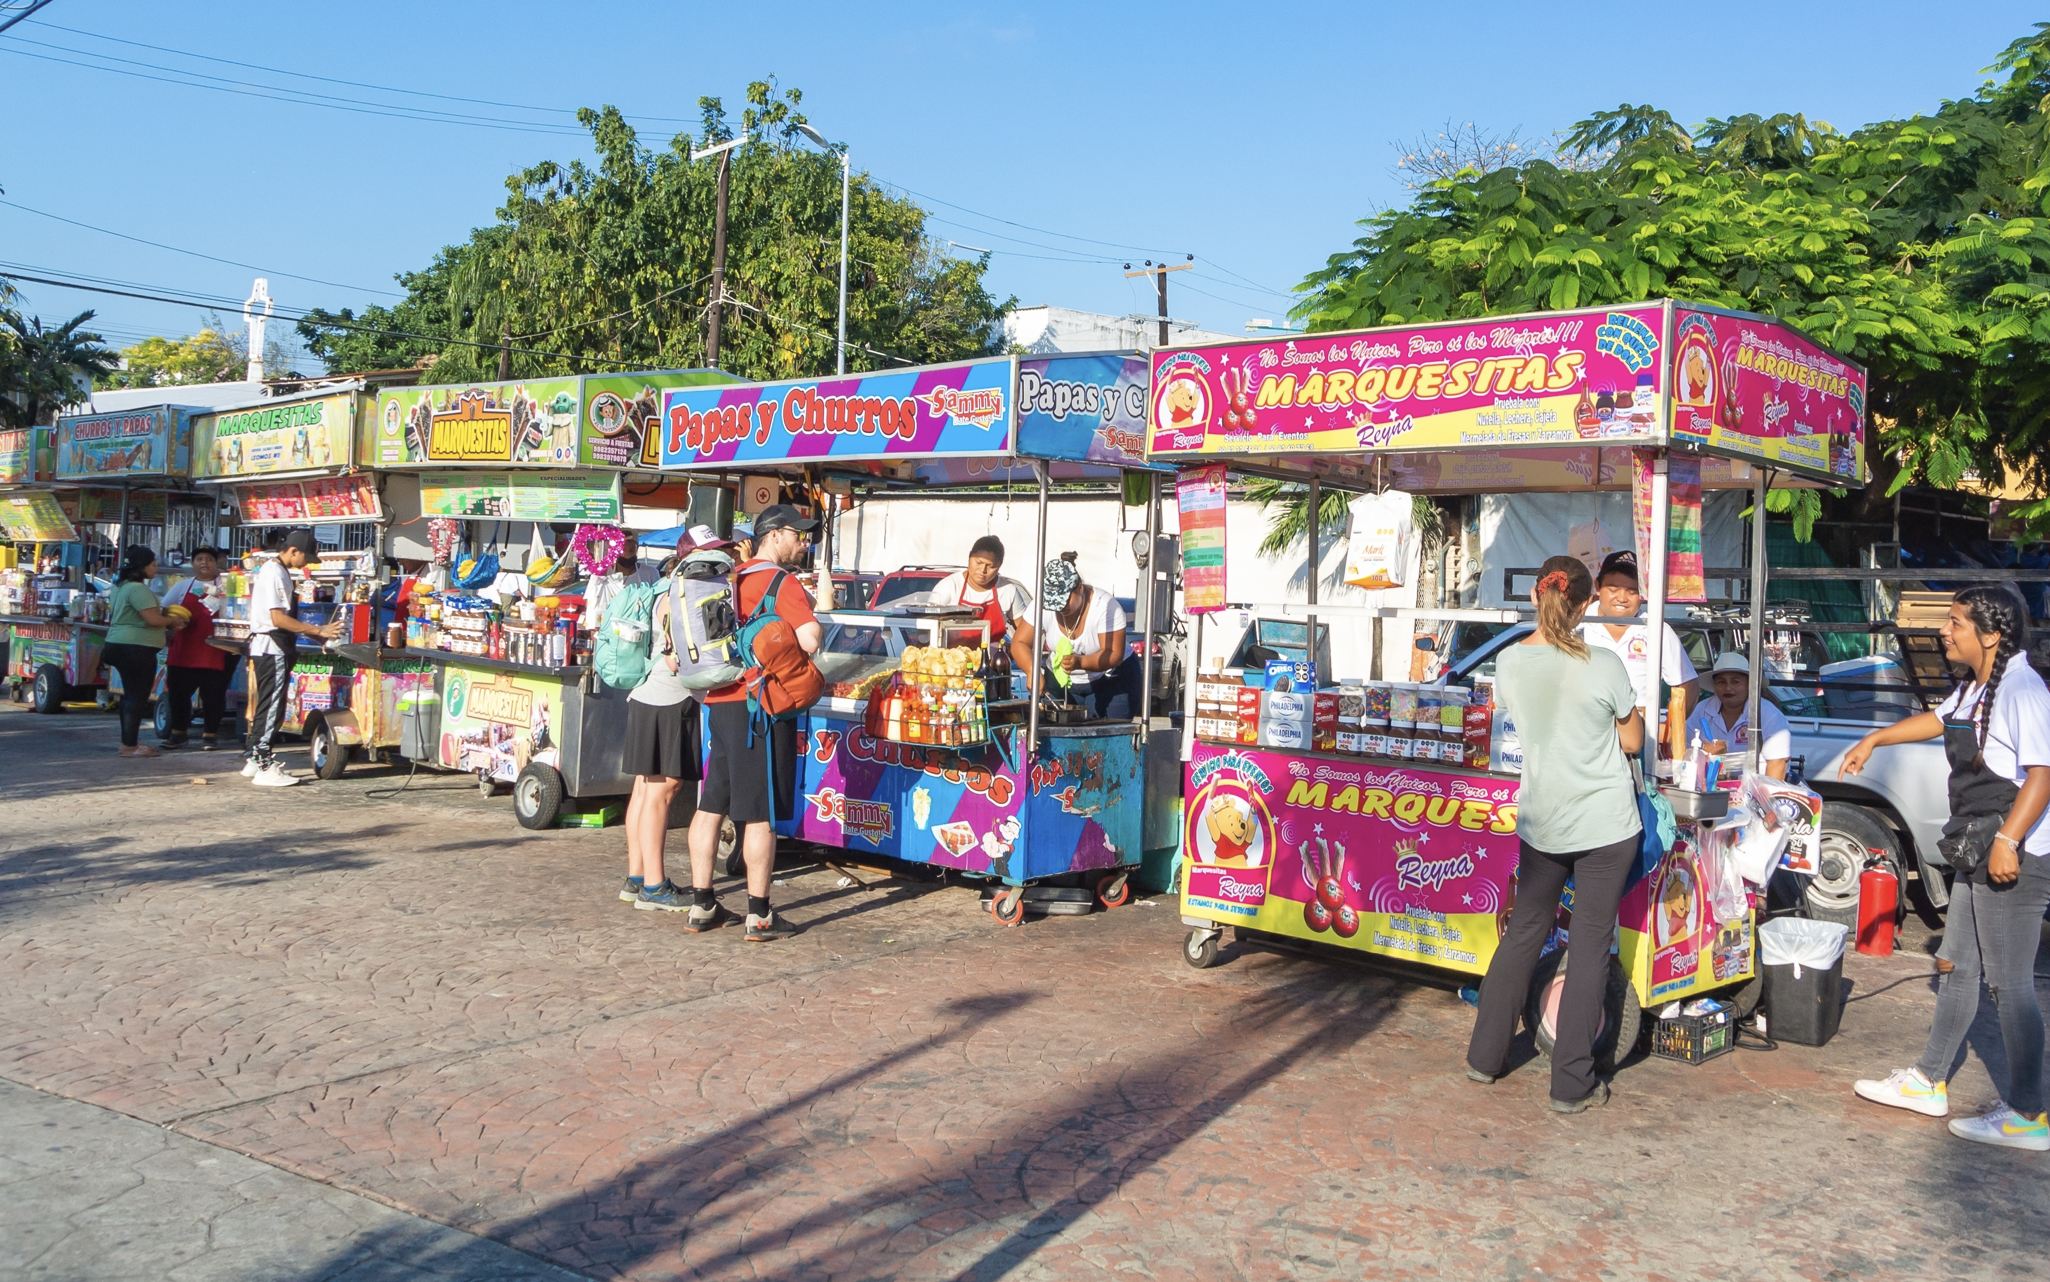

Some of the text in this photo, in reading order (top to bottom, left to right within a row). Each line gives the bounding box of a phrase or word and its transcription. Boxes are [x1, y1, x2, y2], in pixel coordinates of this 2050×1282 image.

[1259, 349, 1278, 367] No
[1282, 348, 1325, 366] Somos
[1329, 345, 1348, 362] los
[1408, 336, 1442, 357] Pero
[1465, 332, 1486, 349] los
[1491, 321, 1583, 351] Mejores!!!
[1598, 326, 1652, 366] CON QUESO
[1608, 314, 1658, 349] RELLENAS
[1599, 339, 1640, 372] DE BOLA
[1736, 344, 1848, 398] MARQUESITAS
[1255, 351, 1585, 409] MARQUESITAS
[933, 389, 1000, 416] Sammy
[1020, 372, 1099, 419] Papas
[1103, 388, 1120, 421] y
[75, 414, 152, 440] CHURROS Y PAPAS
[216, 402, 323, 437] MARQUESITAS
[669, 405, 751, 453] Papas
[756, 402, 777, 444] y
[783, 389, 917, 438] Churros
[1764, 401, 1789, 426] Reyna
[432, 418, 507, 460] MARQUESITAS
[1279, 431, 1308, 440] Eventos
[1356, 416, 1413, 447] Reyna
[1269, 666, 1293, 676] OREO
[1270, 701, 1304, 711] PHILADELPHIA
[815, 731, 841, 763] y
[1268, 728, 1302, 739] PHILADELPHIA
[1222, 755, 1242, 768] PARA
[1243, 760, 1274, 795] EVENTOS
[1289, 761, 1309, 776] No
[1315, 766, 1361, 782] Somos
[1365, 771, 1385, 785] los
[1451, 781, 1488, 799] Pero
[821, 791, 890, 833] Sammy
[1191, 867, 1227, 875] Marquesitas
[1397, 854, 1474, 891] Reyna
[1219, 876, 1264, 902] Reyna
[1373, 931, 1477, 963] Mermelada de Fresas y Zarzamora
[1441, 925, 1462, 944] Cajeta
[1671, 950, 1698, 977] Reyna
